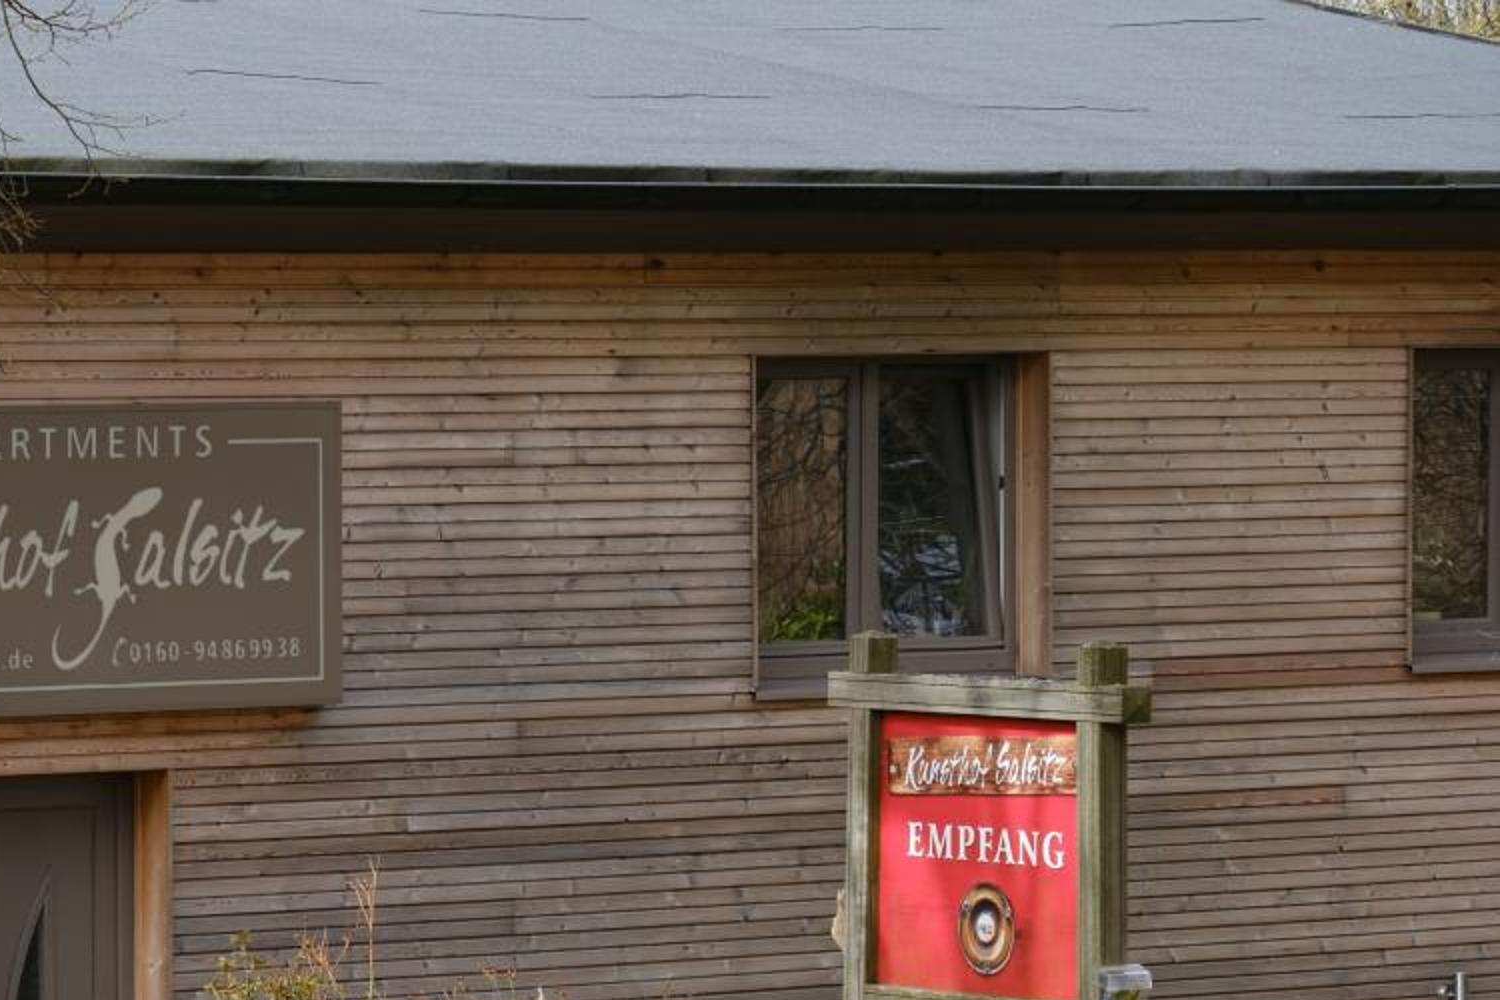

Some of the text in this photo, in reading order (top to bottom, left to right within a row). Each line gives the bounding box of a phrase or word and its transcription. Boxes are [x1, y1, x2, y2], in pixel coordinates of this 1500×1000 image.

[50, 486, 307, 671] Salsitz
[904, 740, 1067, 791] Kunsthof Salsitz
[906, 820, 1066, 870] EMPFANG
